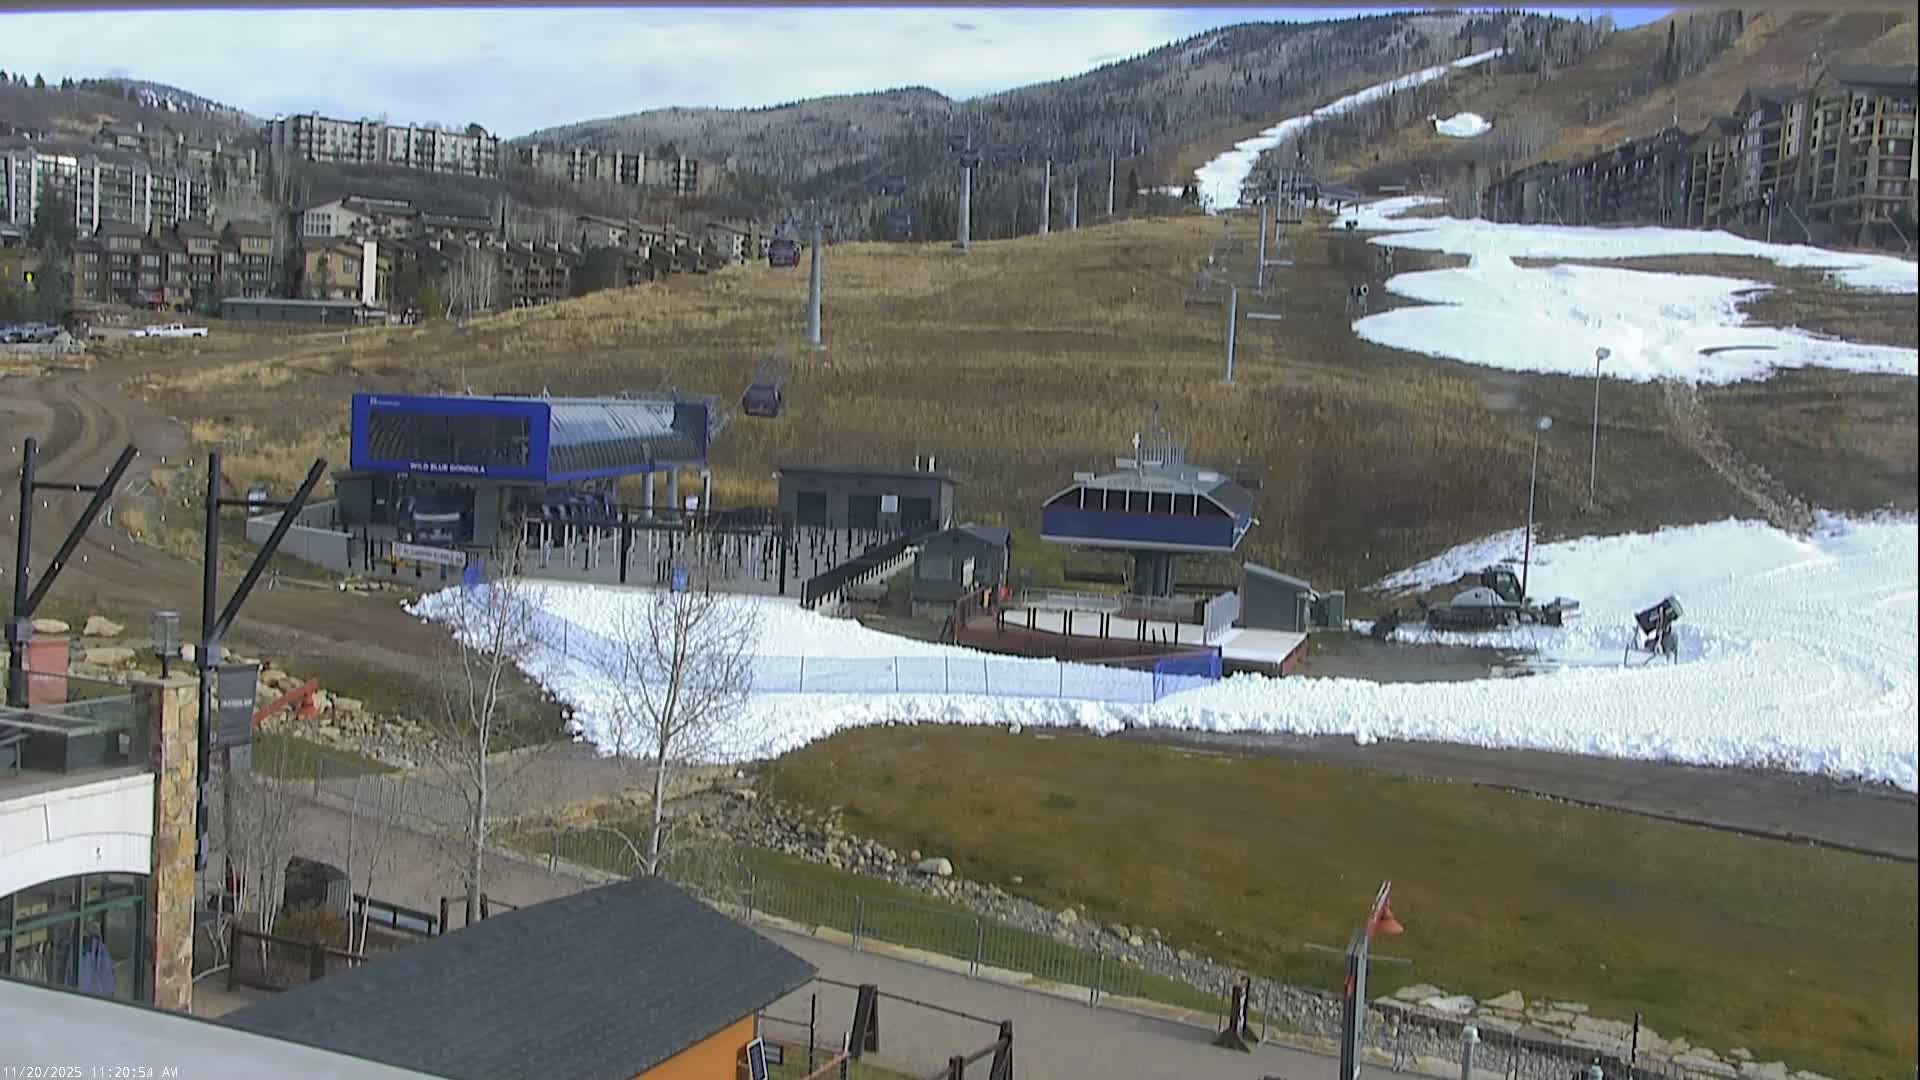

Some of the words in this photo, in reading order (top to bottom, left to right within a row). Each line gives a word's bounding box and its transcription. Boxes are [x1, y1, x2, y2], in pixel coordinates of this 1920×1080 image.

[409, 462, 429, 471] WILD
[430, 463, 448, 472] BLUE
[449, 463, 486, 474] GONDOLA
